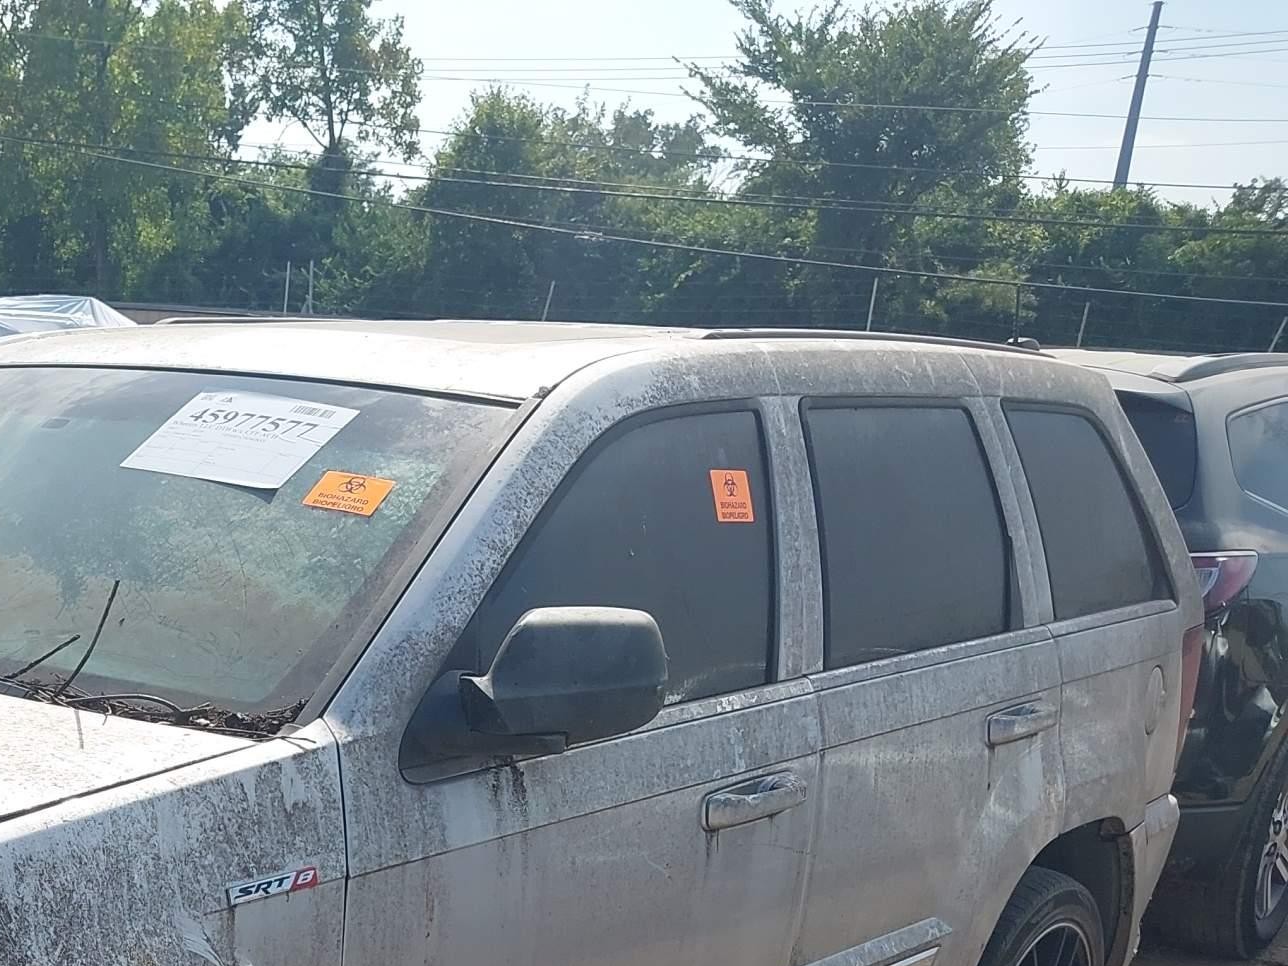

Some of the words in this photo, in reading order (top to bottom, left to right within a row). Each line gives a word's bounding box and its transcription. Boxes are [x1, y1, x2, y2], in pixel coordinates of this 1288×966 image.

[189, 407, 319, 438] 45977577
[312, 498, 365, 512] BIOPELIGRO
[318, 492, 369, 506] BIOHAZARD
